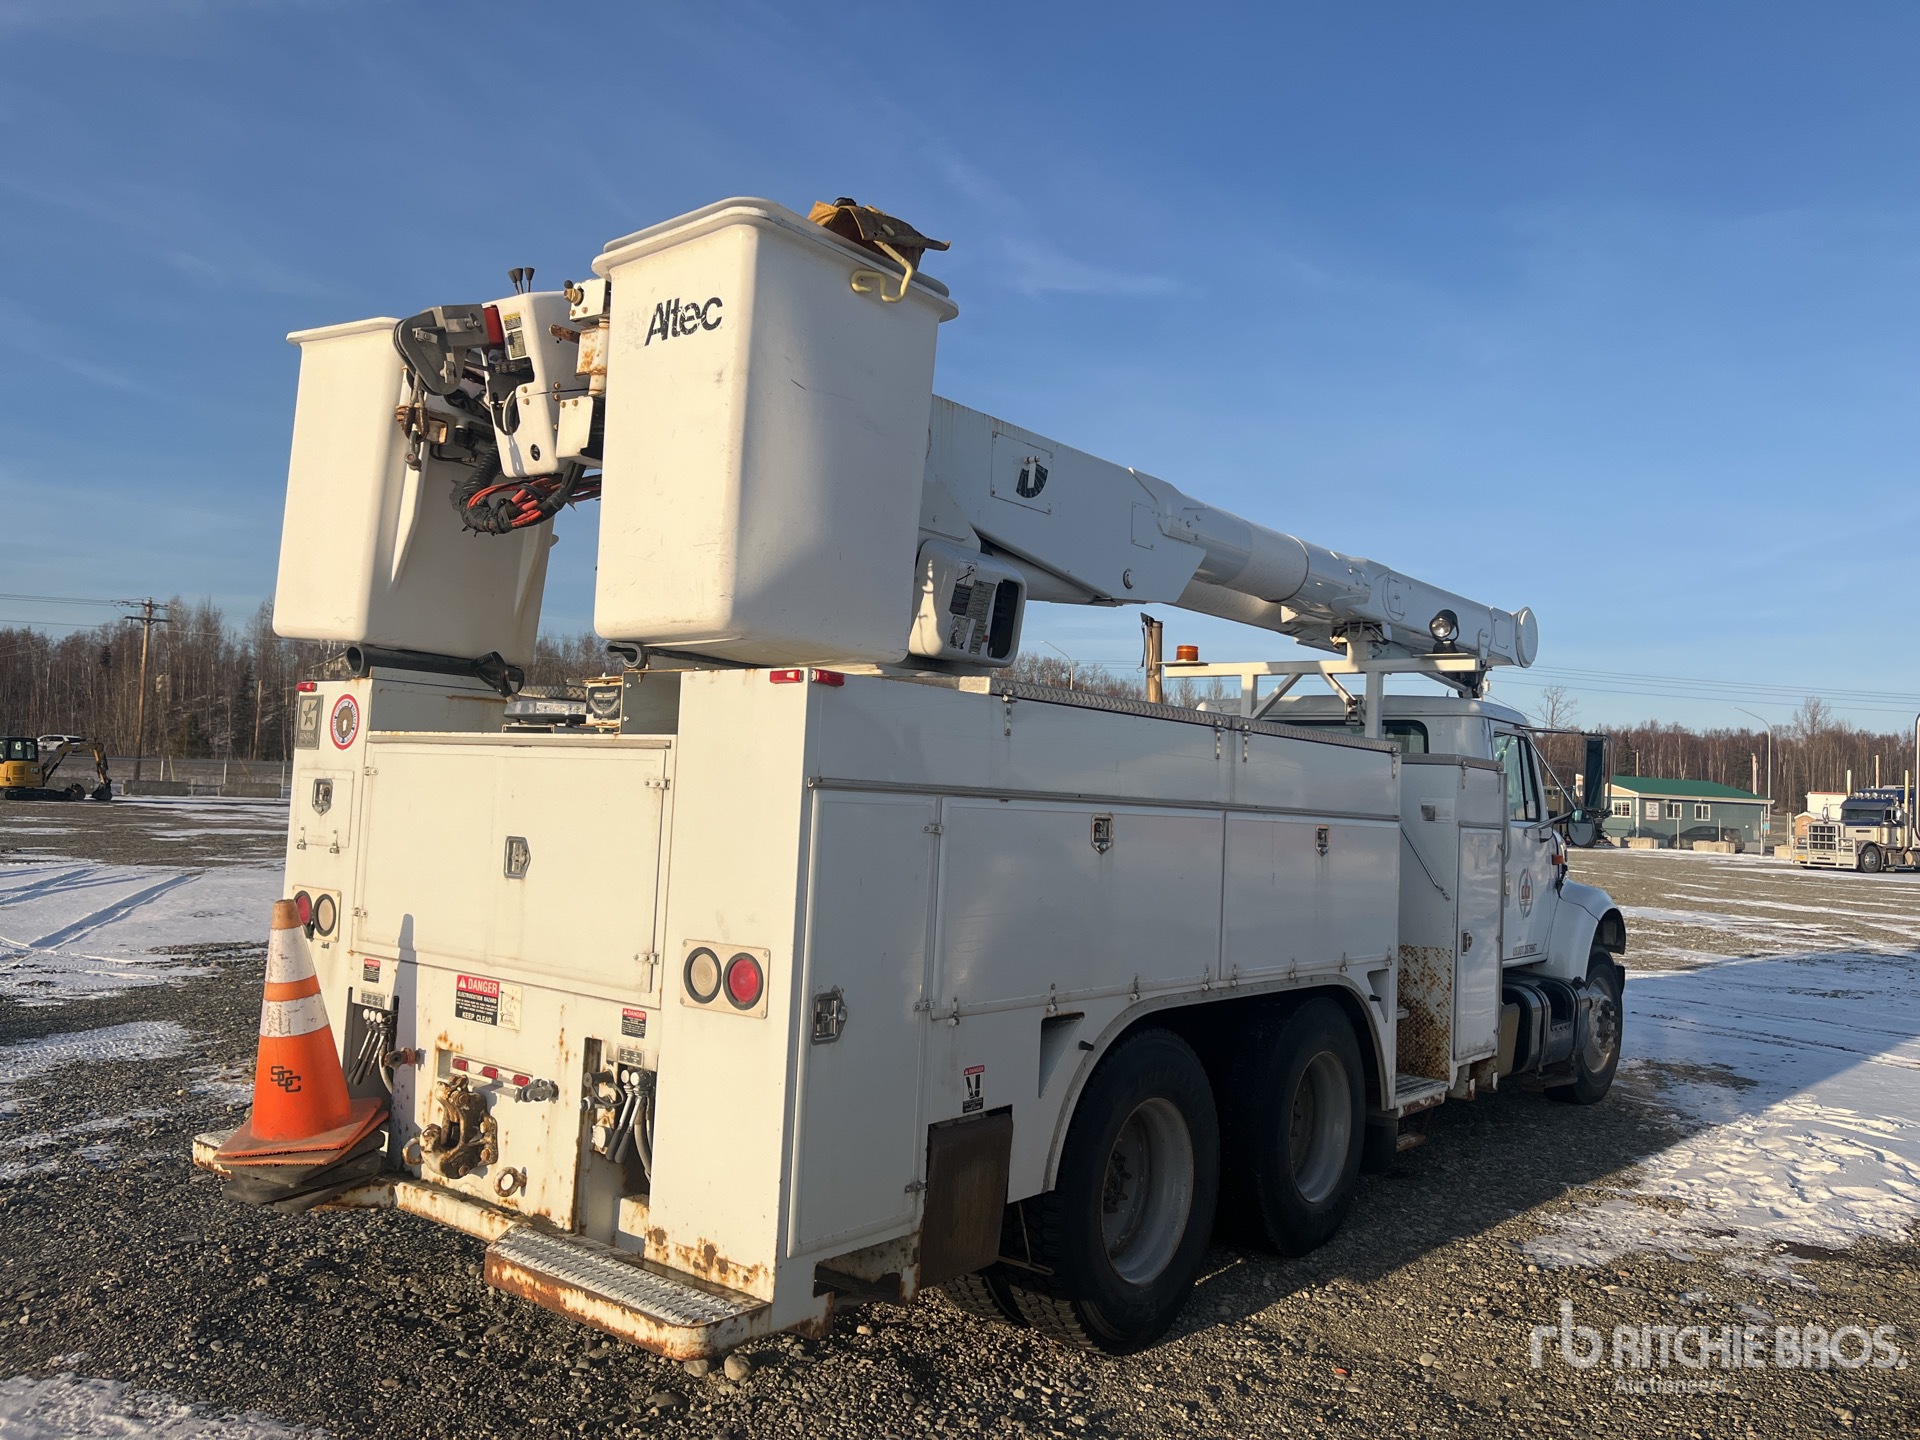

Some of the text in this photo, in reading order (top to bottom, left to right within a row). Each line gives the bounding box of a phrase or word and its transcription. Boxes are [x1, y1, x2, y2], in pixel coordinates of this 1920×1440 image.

[644, 297, 723, 347] Altec
[468, 978, 498, 995] DANGER
[462, 1011, 492, 1024] KEEP CLEAR
[627, 1009, 646, 1019] DANGER
[969, 1066, 984, 1074] DANGER
